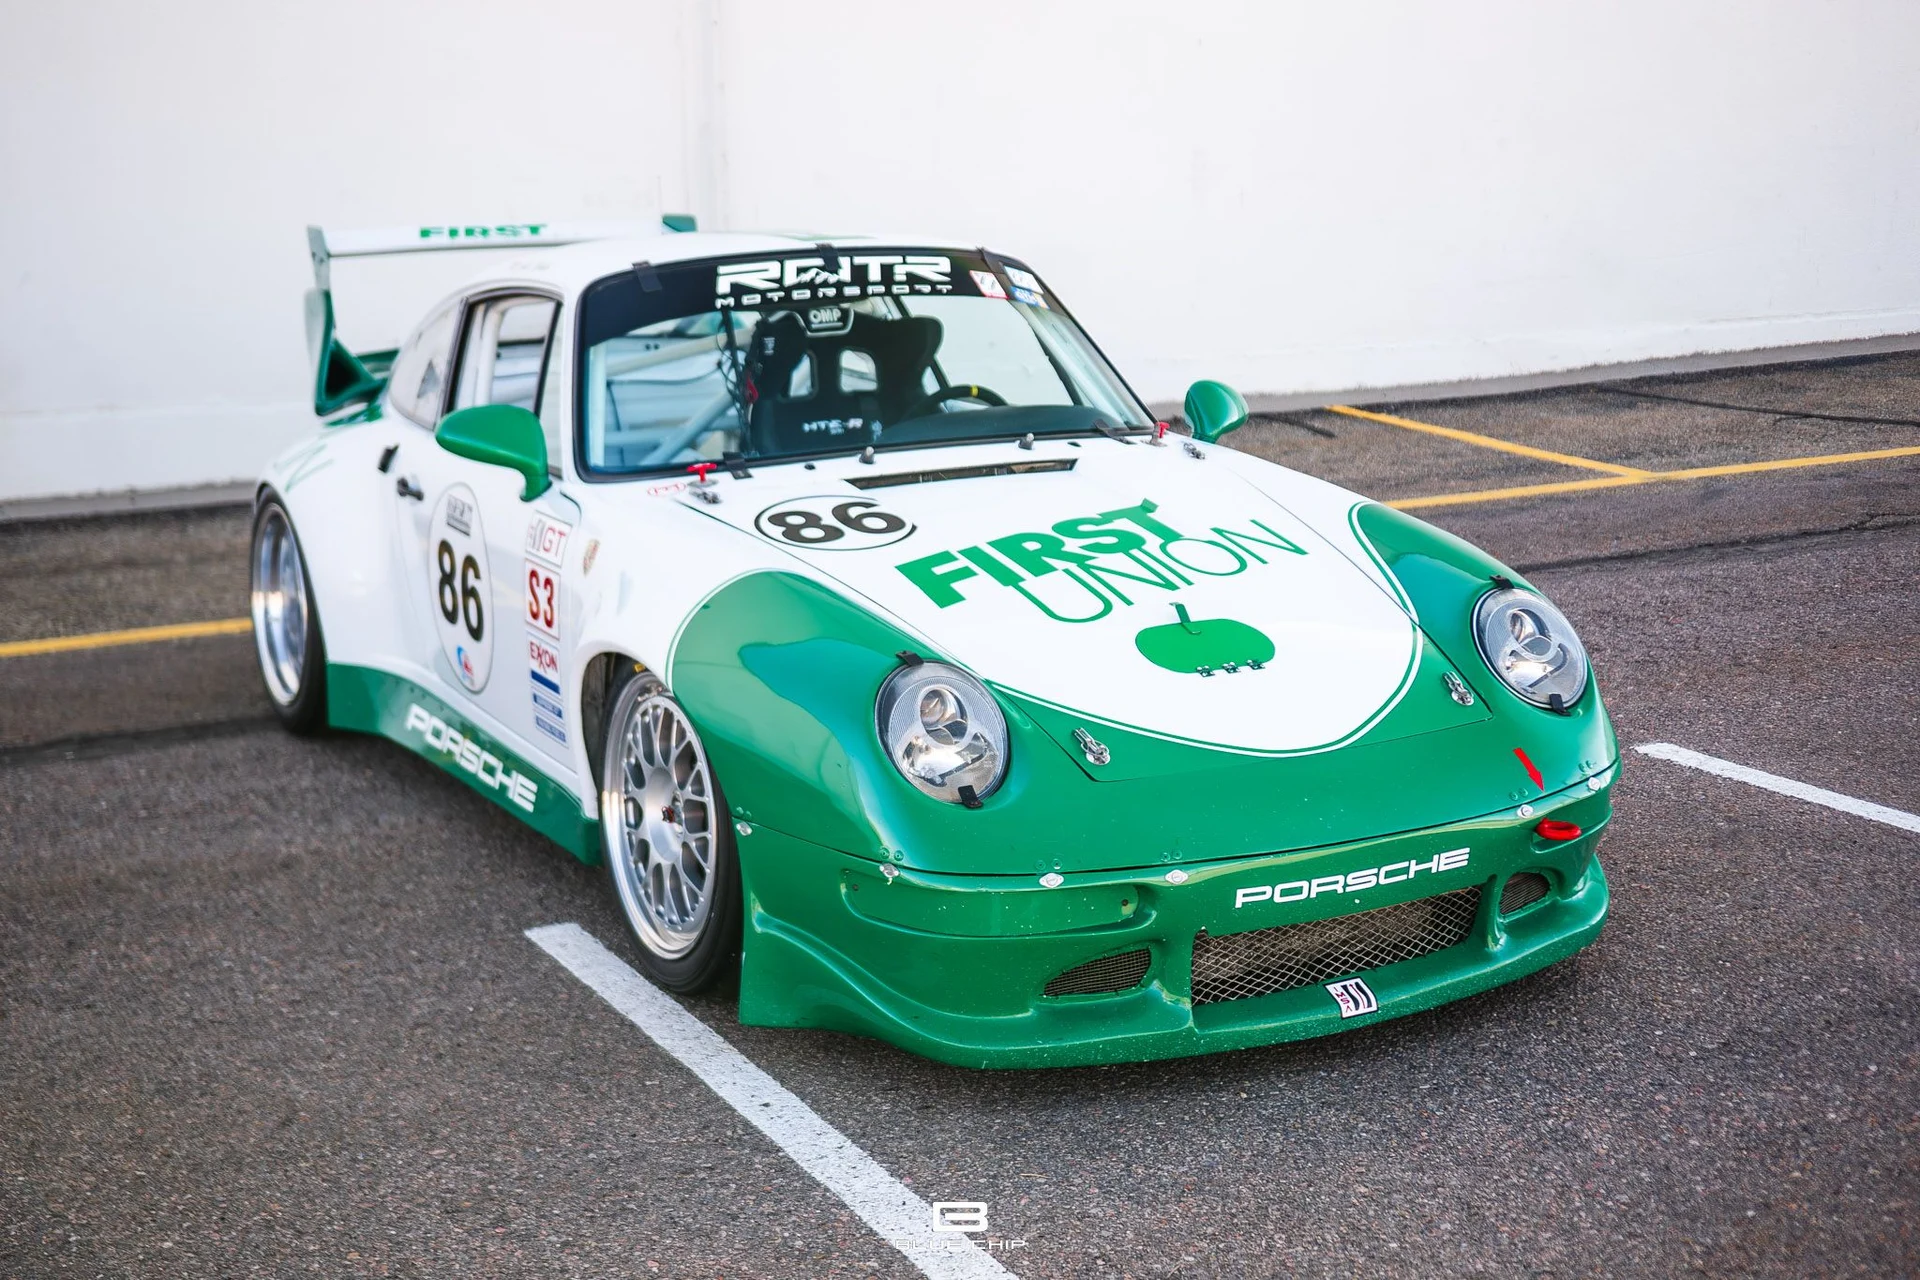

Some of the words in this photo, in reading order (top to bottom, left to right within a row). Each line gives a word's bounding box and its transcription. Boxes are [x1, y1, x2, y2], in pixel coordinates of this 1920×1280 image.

[419, 223, 548, 241] FIRST
[715, 284, 952, 309] MOTORSPORT
[809, 308, 842, 324] OMP
[766, 501, 907, 545] 86
[895, 497, 1185, 609] FIRST
[437, 539, 484, 643] 86
[528, 568, 556, 630] S3
[1009, 517, 1308, 623] UNION
[529, 641, 558, 674] EXXON
[407, 705, 538, 812] PORSCHE
[1234, 847, 1470, 909] PORSCHE
